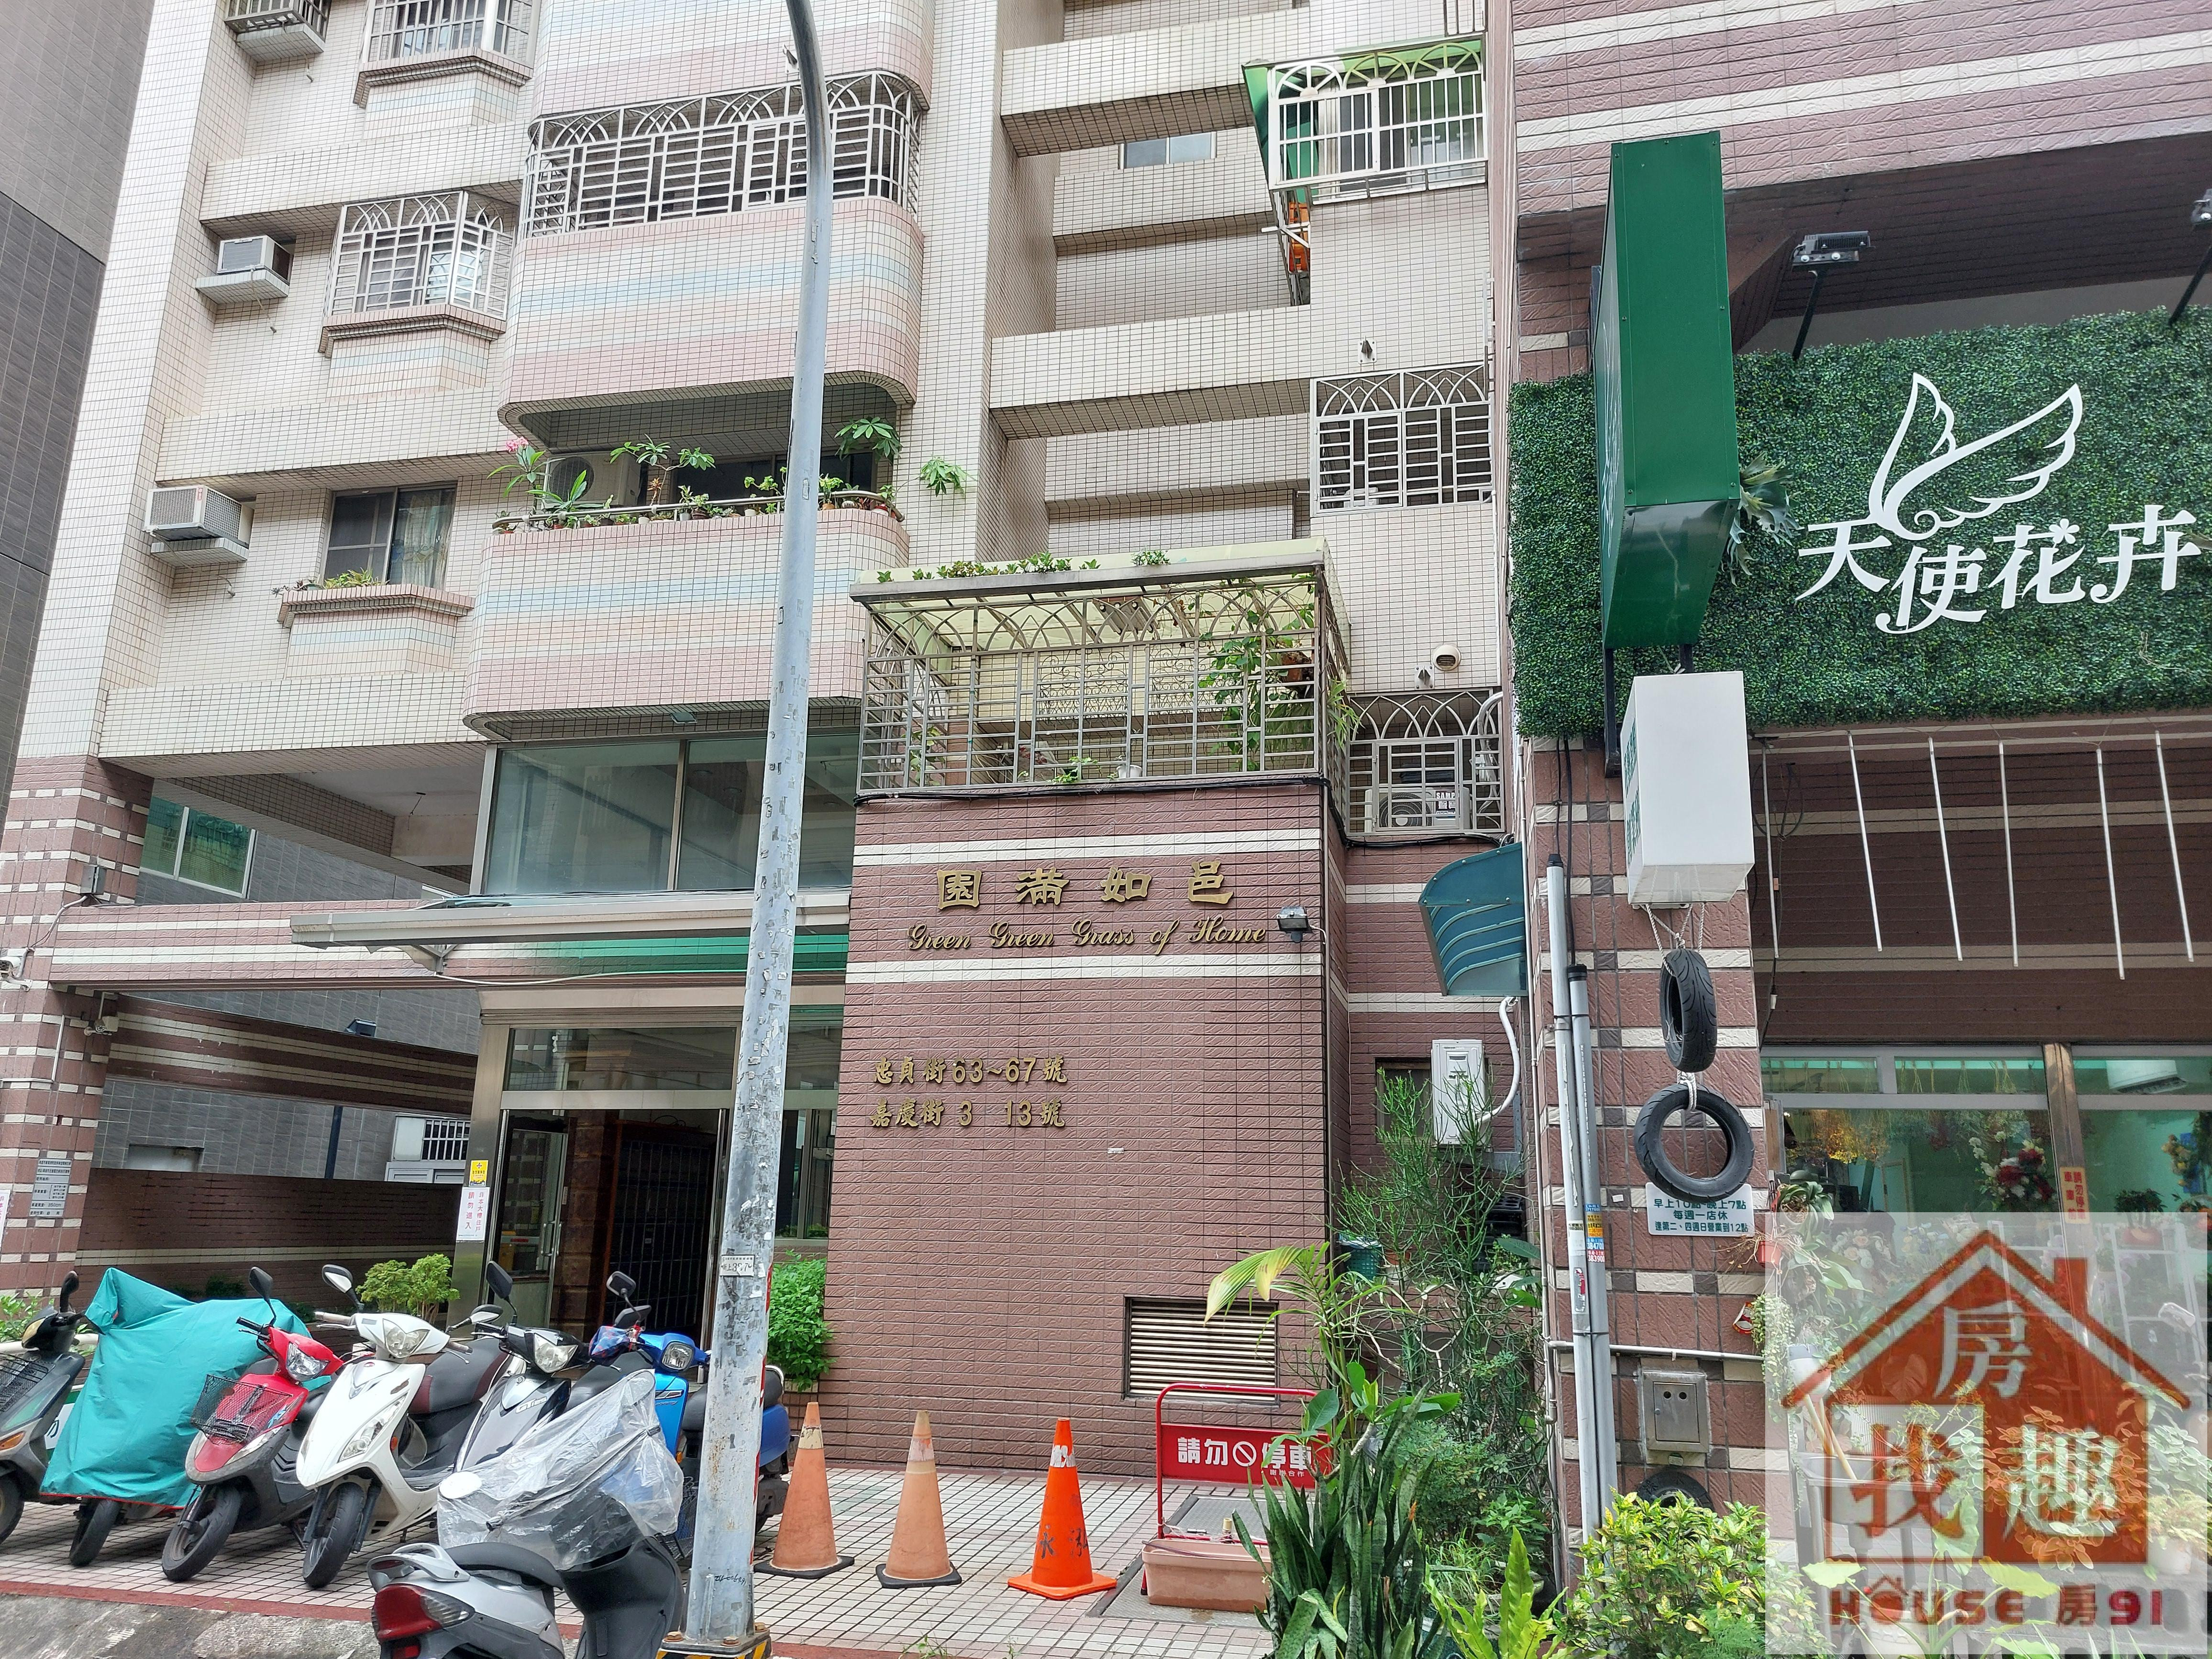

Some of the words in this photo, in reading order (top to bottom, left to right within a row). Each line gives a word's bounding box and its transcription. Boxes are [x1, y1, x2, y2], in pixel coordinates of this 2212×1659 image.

[1795, 505, 2201, 634] 天使花卉
[907, 923, 972, 950] Green
[988, 921, 1054, 948] Green
[1071, 918, 1135, 946] Grass
[1149, 919, 1179, 956] of
[1188, 915, 1266, 943] Home
[465, 1192, 475, 1229] 請勿進入
[1673, 1210, 1728, 1220] 每週一店休
